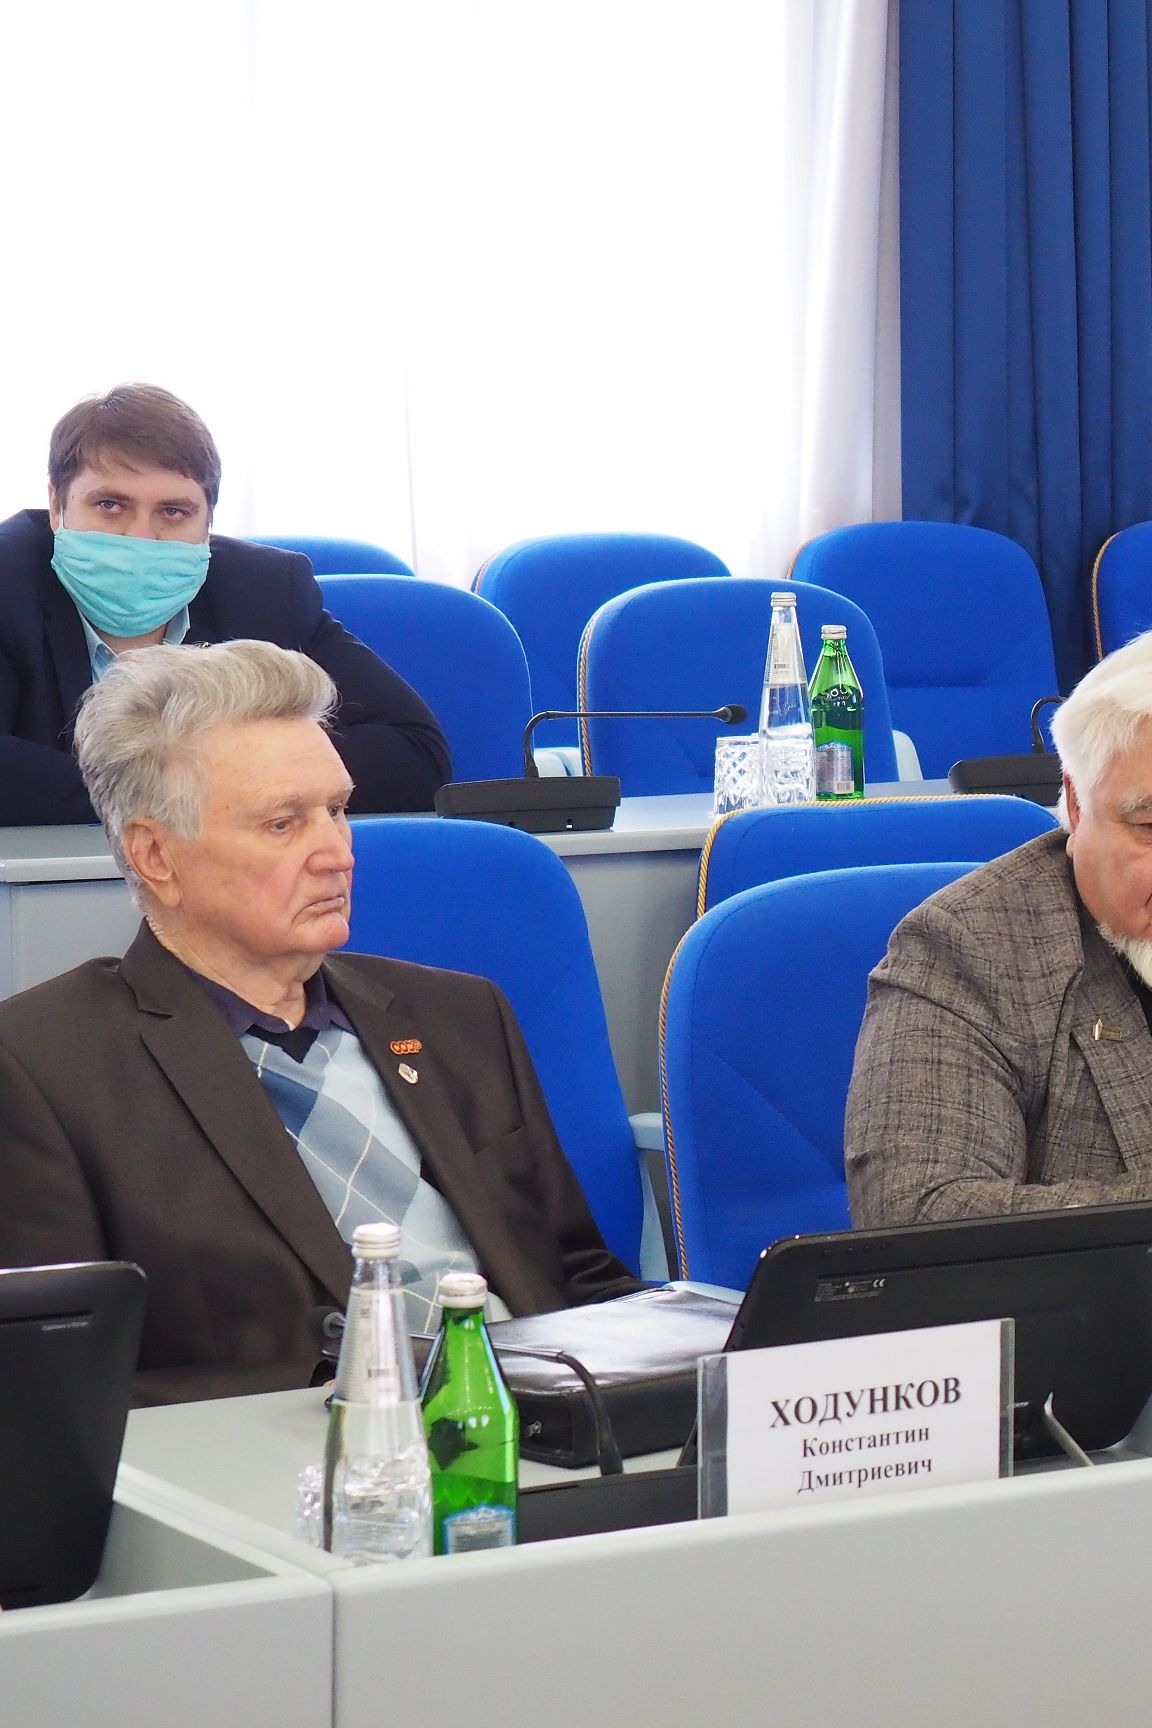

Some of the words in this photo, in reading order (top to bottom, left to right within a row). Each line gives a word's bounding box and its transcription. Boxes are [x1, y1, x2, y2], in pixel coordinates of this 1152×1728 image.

[769, 1376, 961, 1428] ХОДУНКОВ
[801, 1427, 930, 1458] Константин
[797, 1458, 932, 1494] Дмитриевич
